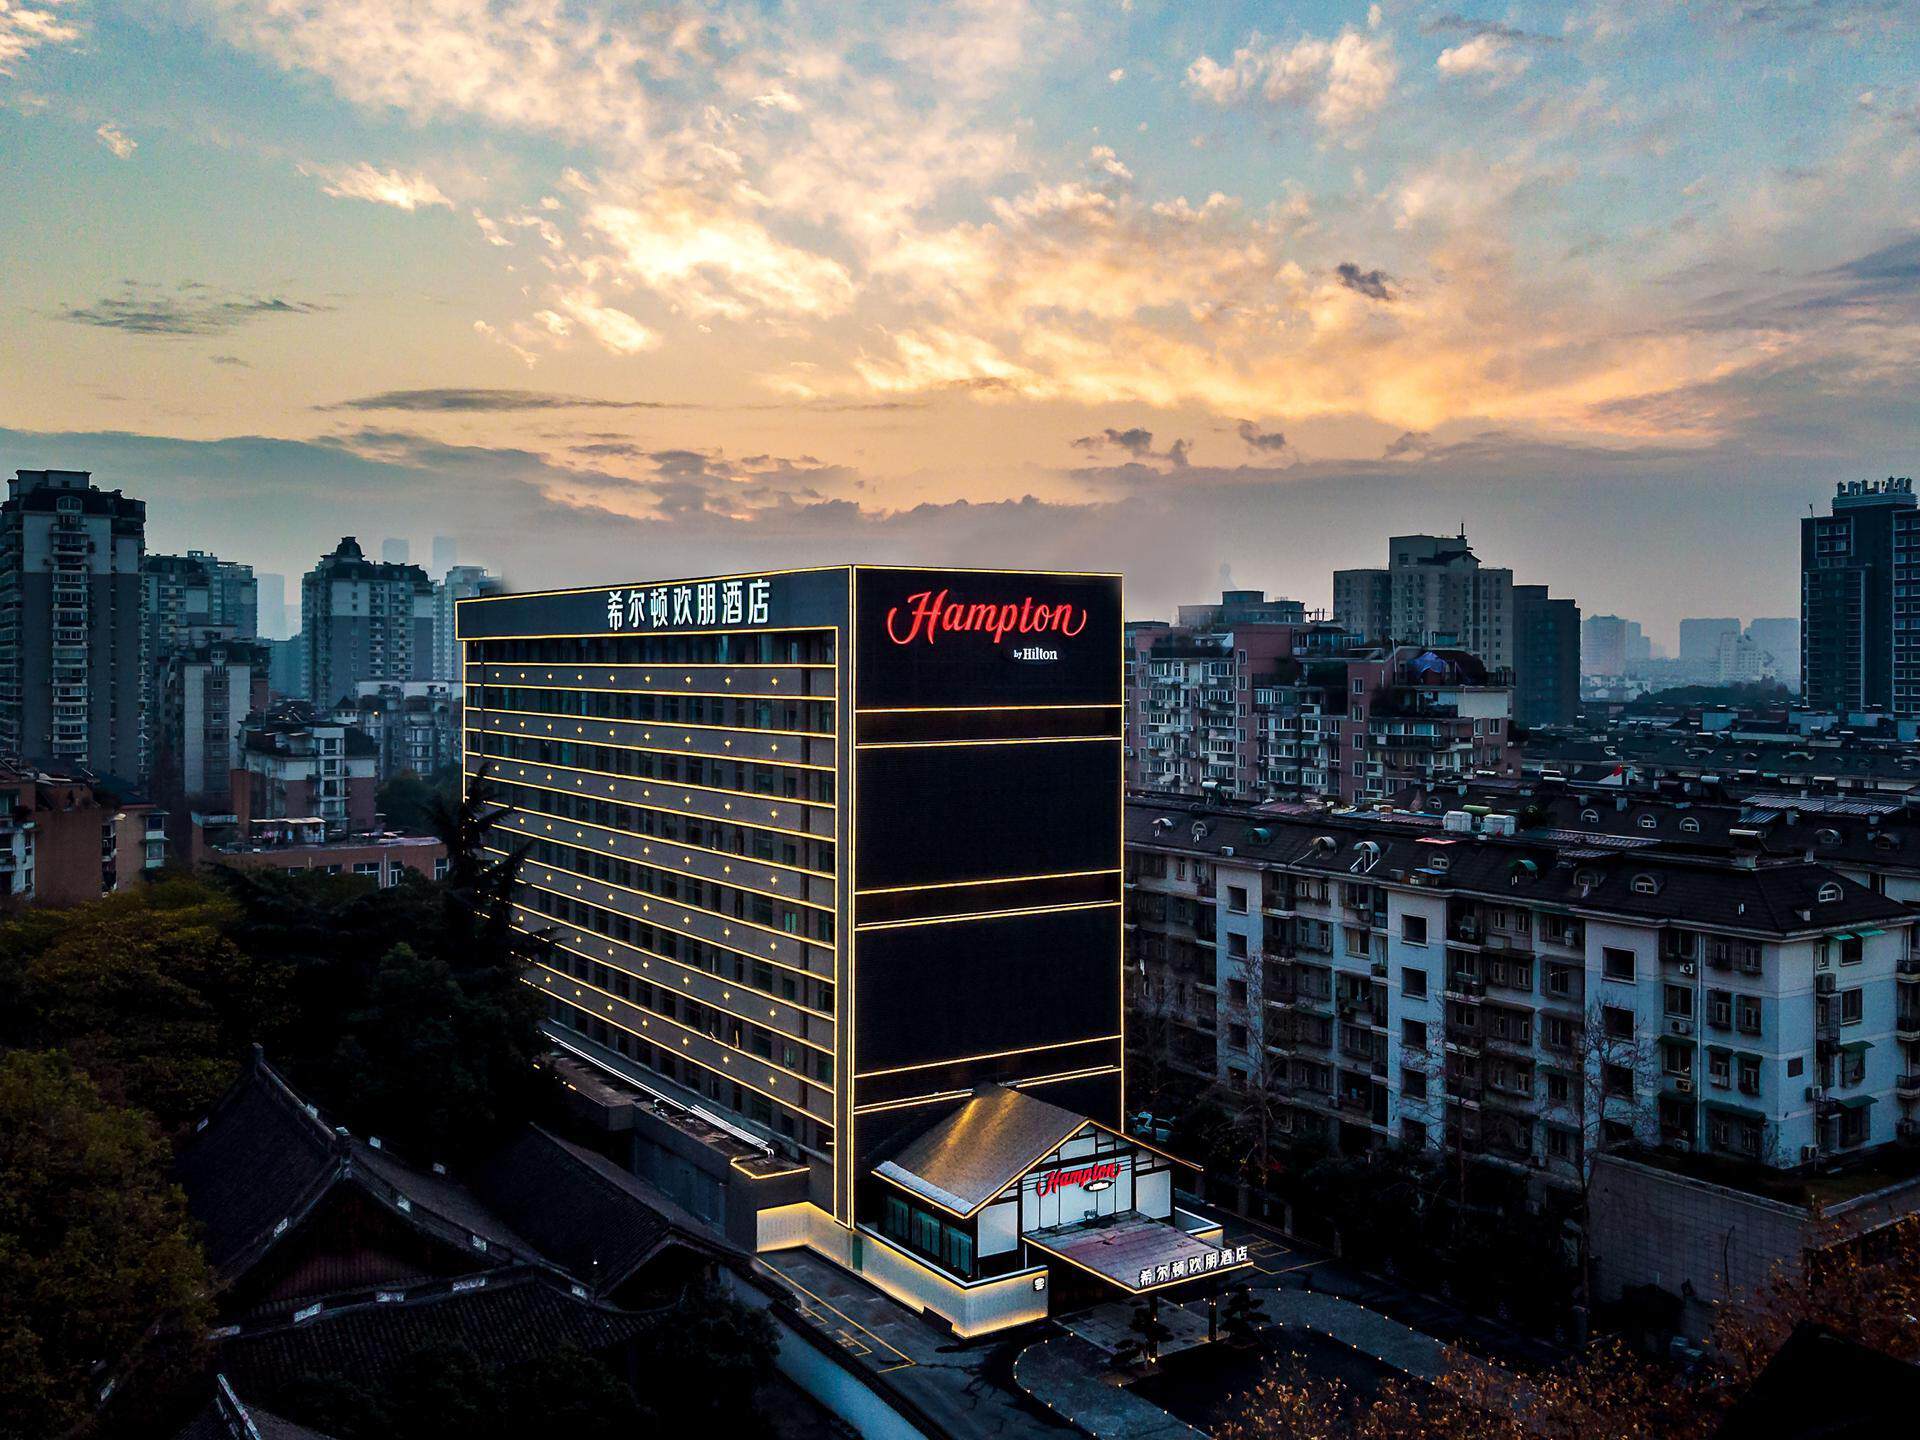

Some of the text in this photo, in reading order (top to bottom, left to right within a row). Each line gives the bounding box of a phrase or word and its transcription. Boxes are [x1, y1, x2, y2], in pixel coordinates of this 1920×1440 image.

[607, 578, 771, 631] 希尔顿欢朋酒店
[886, 588, 1088, 645] Hampton
[1013, 647, 1058, 660] by Hilton
[1036, 1161, 1122, 1198] Hampton
[1139, 1245, 1249, 1287] 希尔顿欢朋酒店
